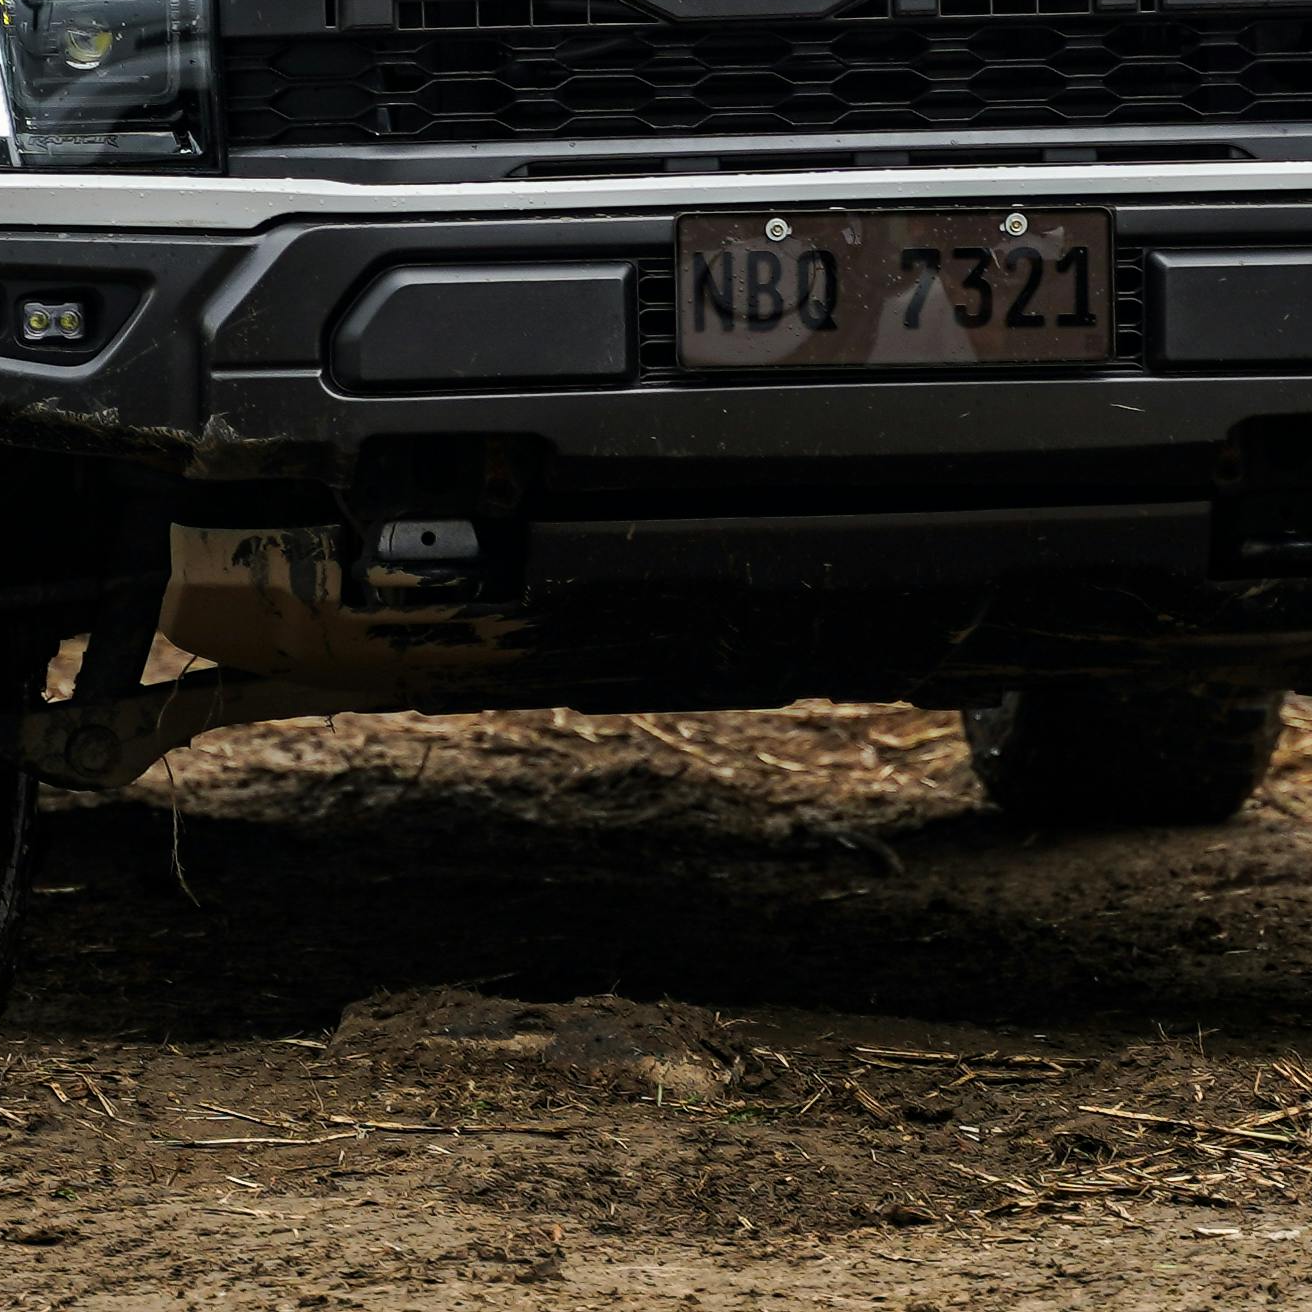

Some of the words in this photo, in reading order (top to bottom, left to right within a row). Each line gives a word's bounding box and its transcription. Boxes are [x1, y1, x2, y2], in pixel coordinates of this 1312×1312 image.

[28, 135, 120, 149] RAPTOR
[691, 249, 839, 333] NBQ
[899, 245, 1098, 329] 7321
